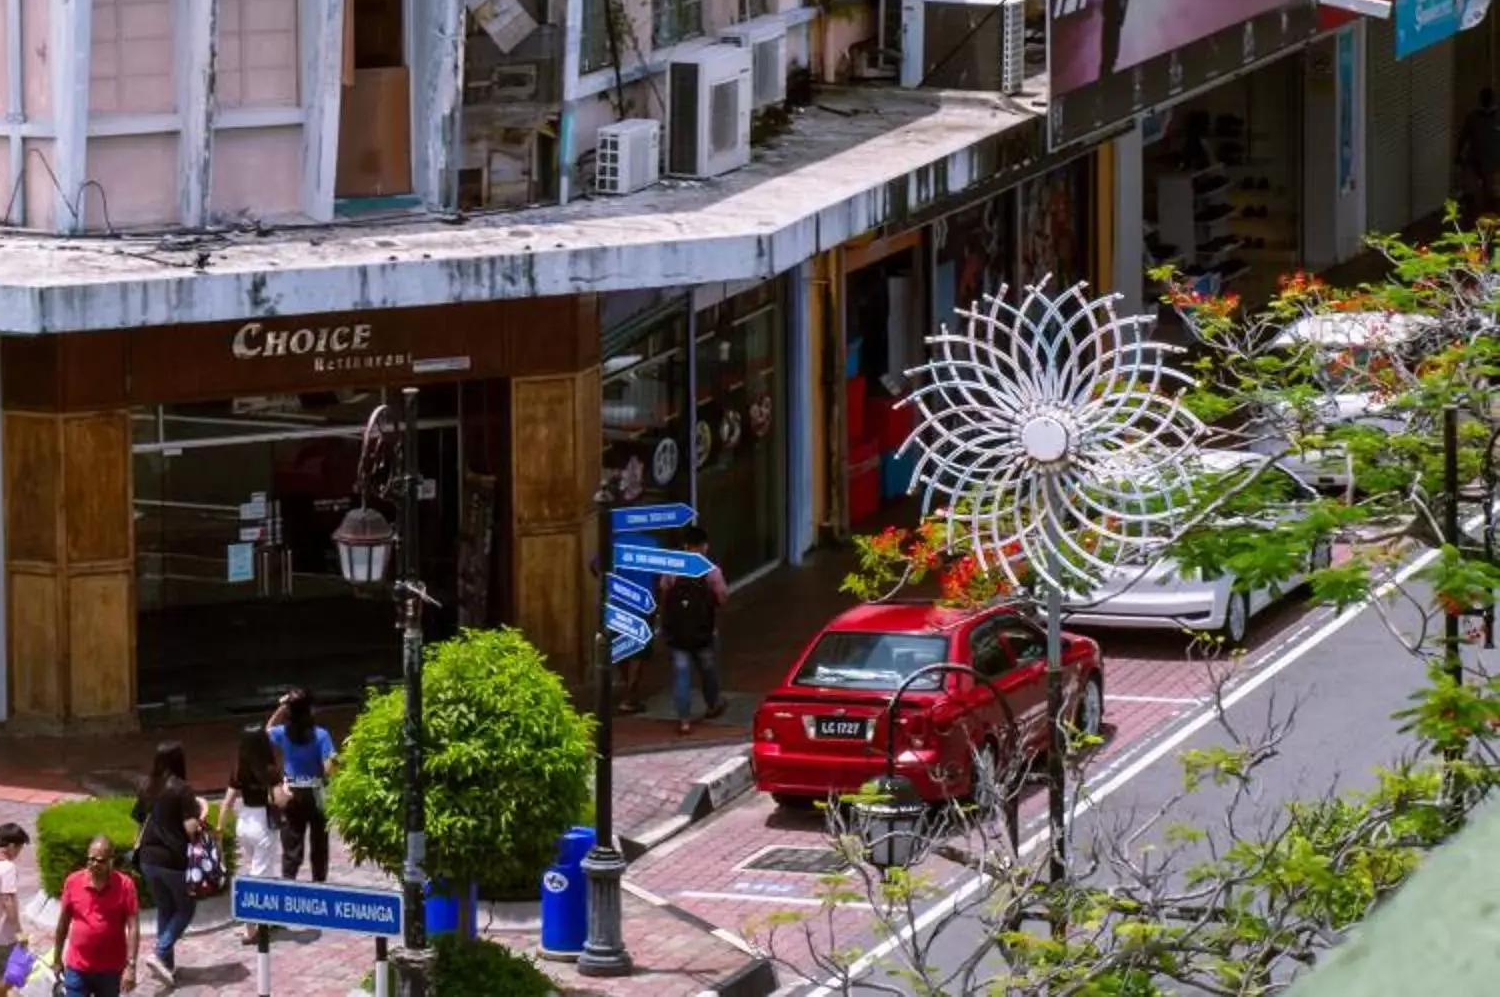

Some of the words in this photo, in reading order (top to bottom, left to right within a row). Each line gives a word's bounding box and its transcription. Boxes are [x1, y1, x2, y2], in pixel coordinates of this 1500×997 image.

[231, 322, 373, 359] CHOICE
[821, 721, 836, 734] LC
[240, 890, 280, 912] JALAN
[283, 894, 329, 917] BUNGA
[334, 900, 395, 924] KENANGA
